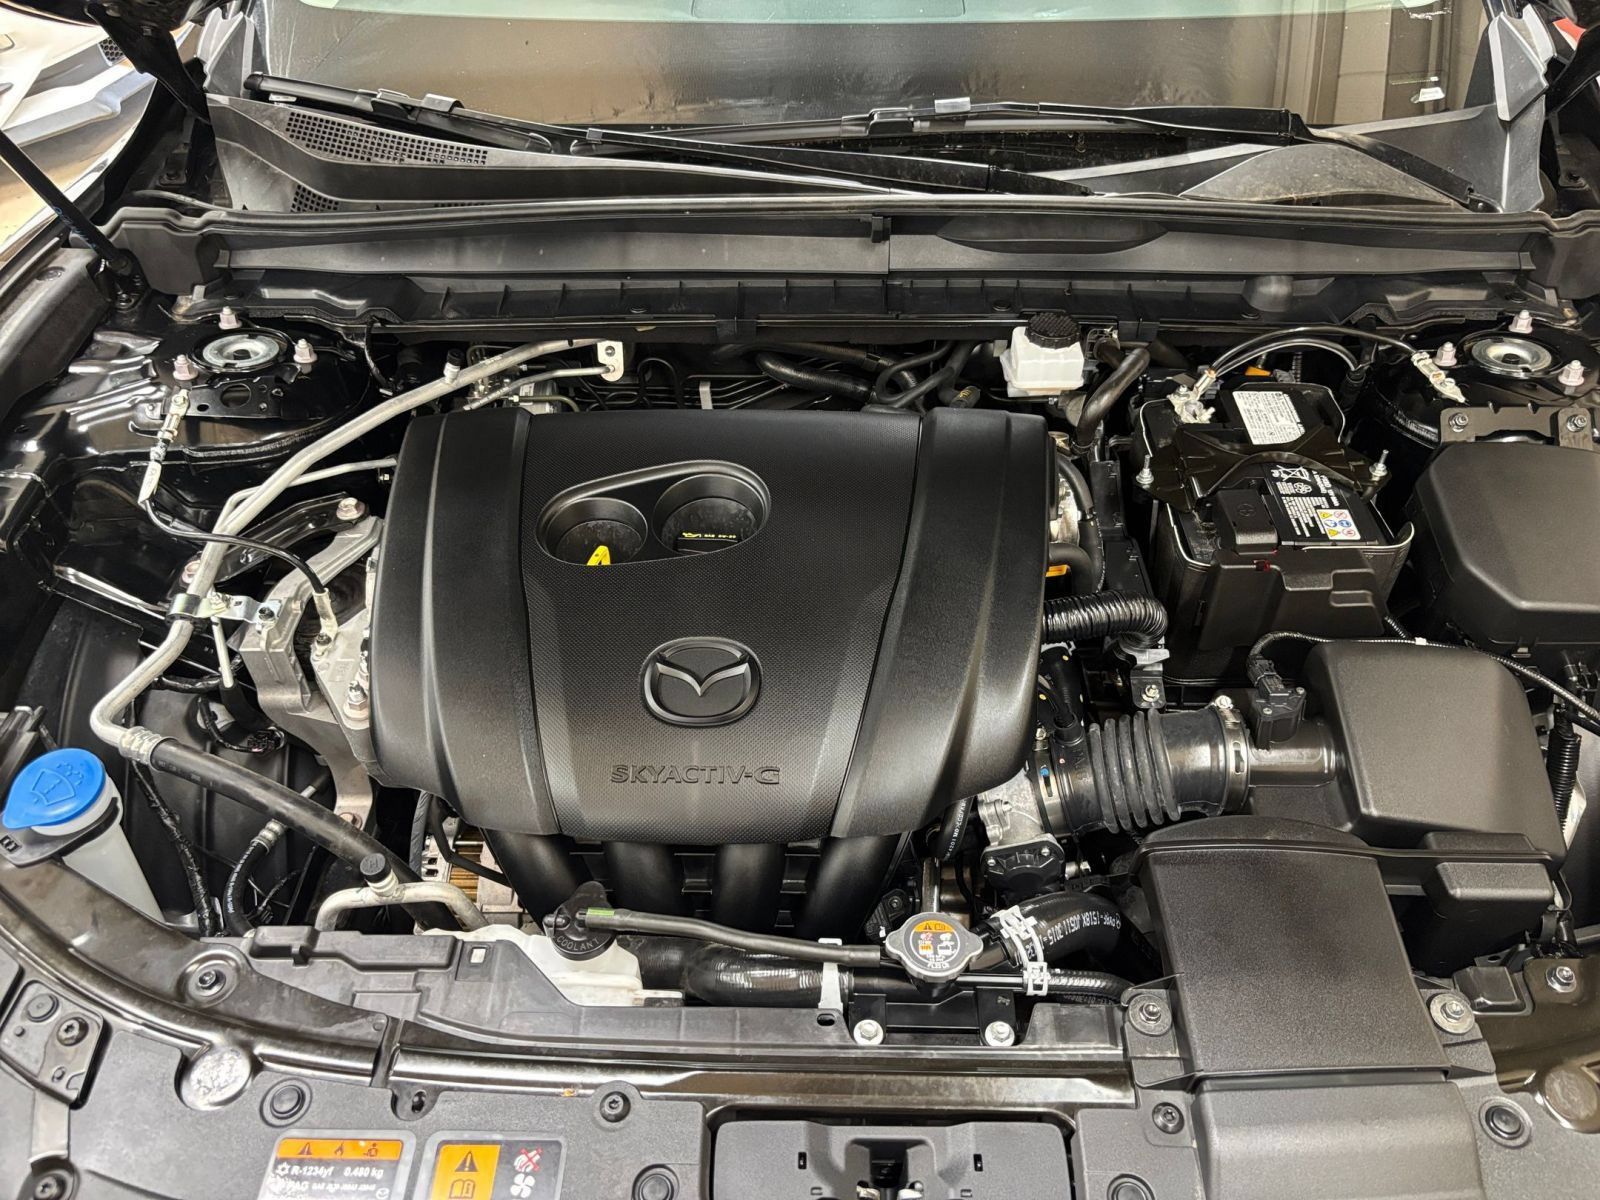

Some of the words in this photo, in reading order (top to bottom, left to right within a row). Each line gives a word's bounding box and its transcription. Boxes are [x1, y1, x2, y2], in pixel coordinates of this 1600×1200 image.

[610, 764, 781, 785] SKYACTIV-G
[556, 935, 600, 952] COOLANT
[290, 1165, 335, 1178] R-1234yf
[370, 1166, 384, 1180] kg
